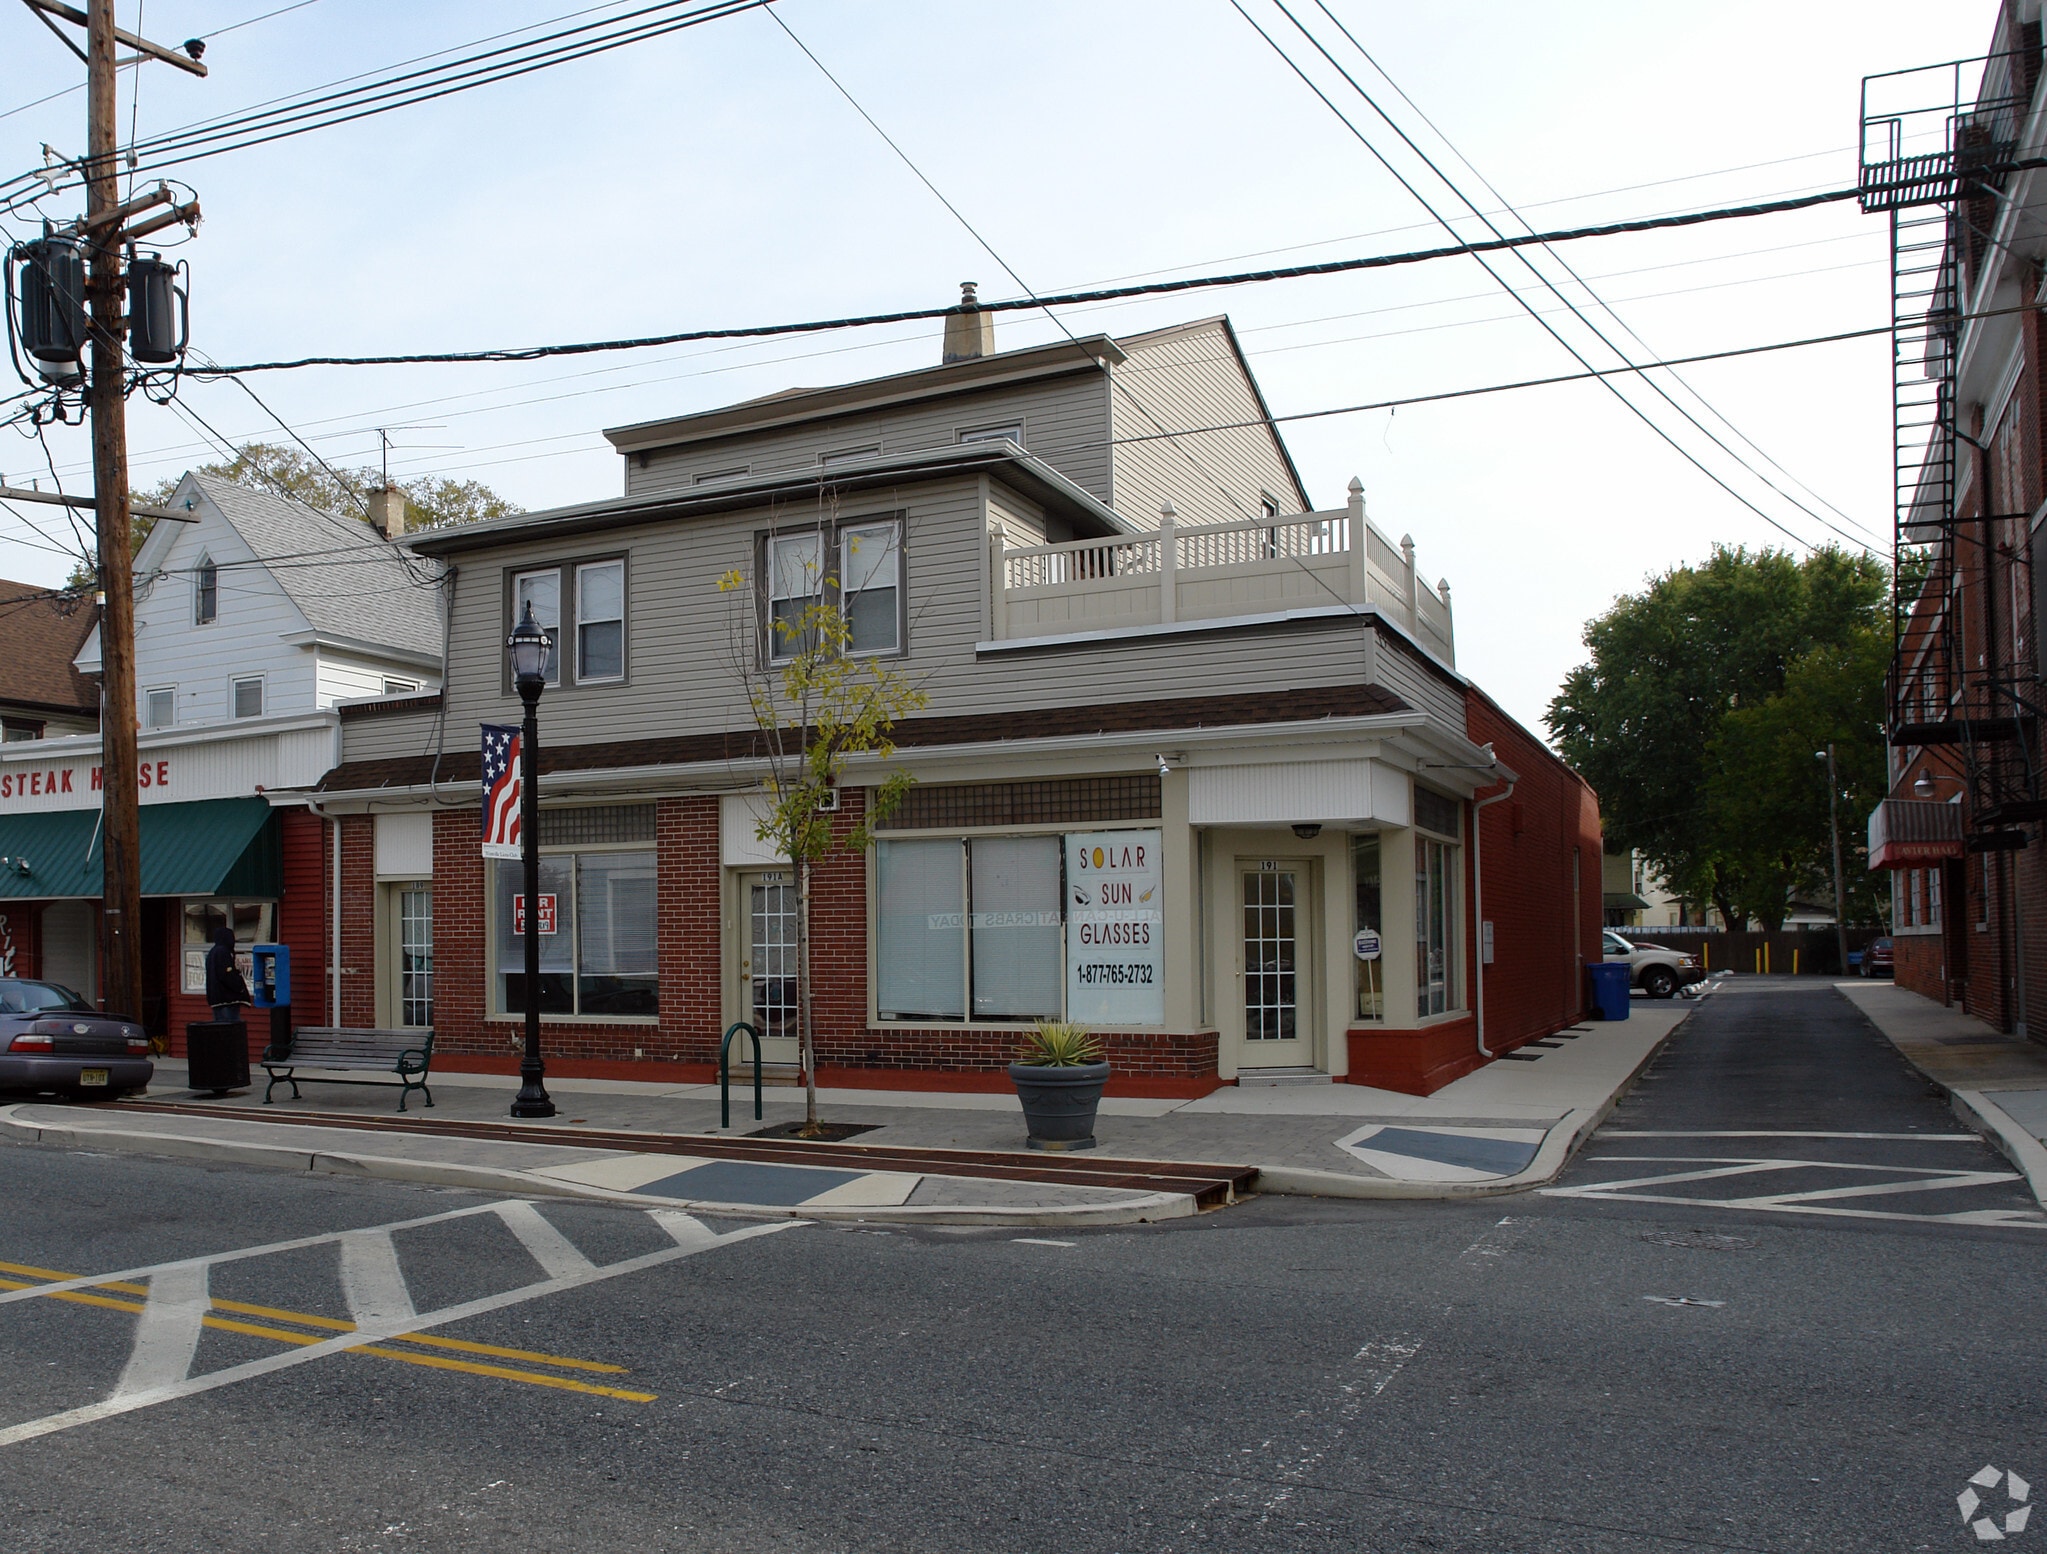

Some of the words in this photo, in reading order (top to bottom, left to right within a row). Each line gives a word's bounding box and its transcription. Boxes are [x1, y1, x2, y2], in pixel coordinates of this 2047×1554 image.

[1, 769, 73, 798] STEAK
[91, 761, 169, 792] HSE
[1080, 846, 1145, 869] SOLAR
[1261, 861, 1276, 870] 191
[763, 871, 782, 881] 191A
[1101, 883, 1131, 904] SUN
[517, 908, 553, 918] RNT
[1080, 922, 1150, 945] GLASSES
[1077, 963, 1153, 984] 1-877-765-2732
